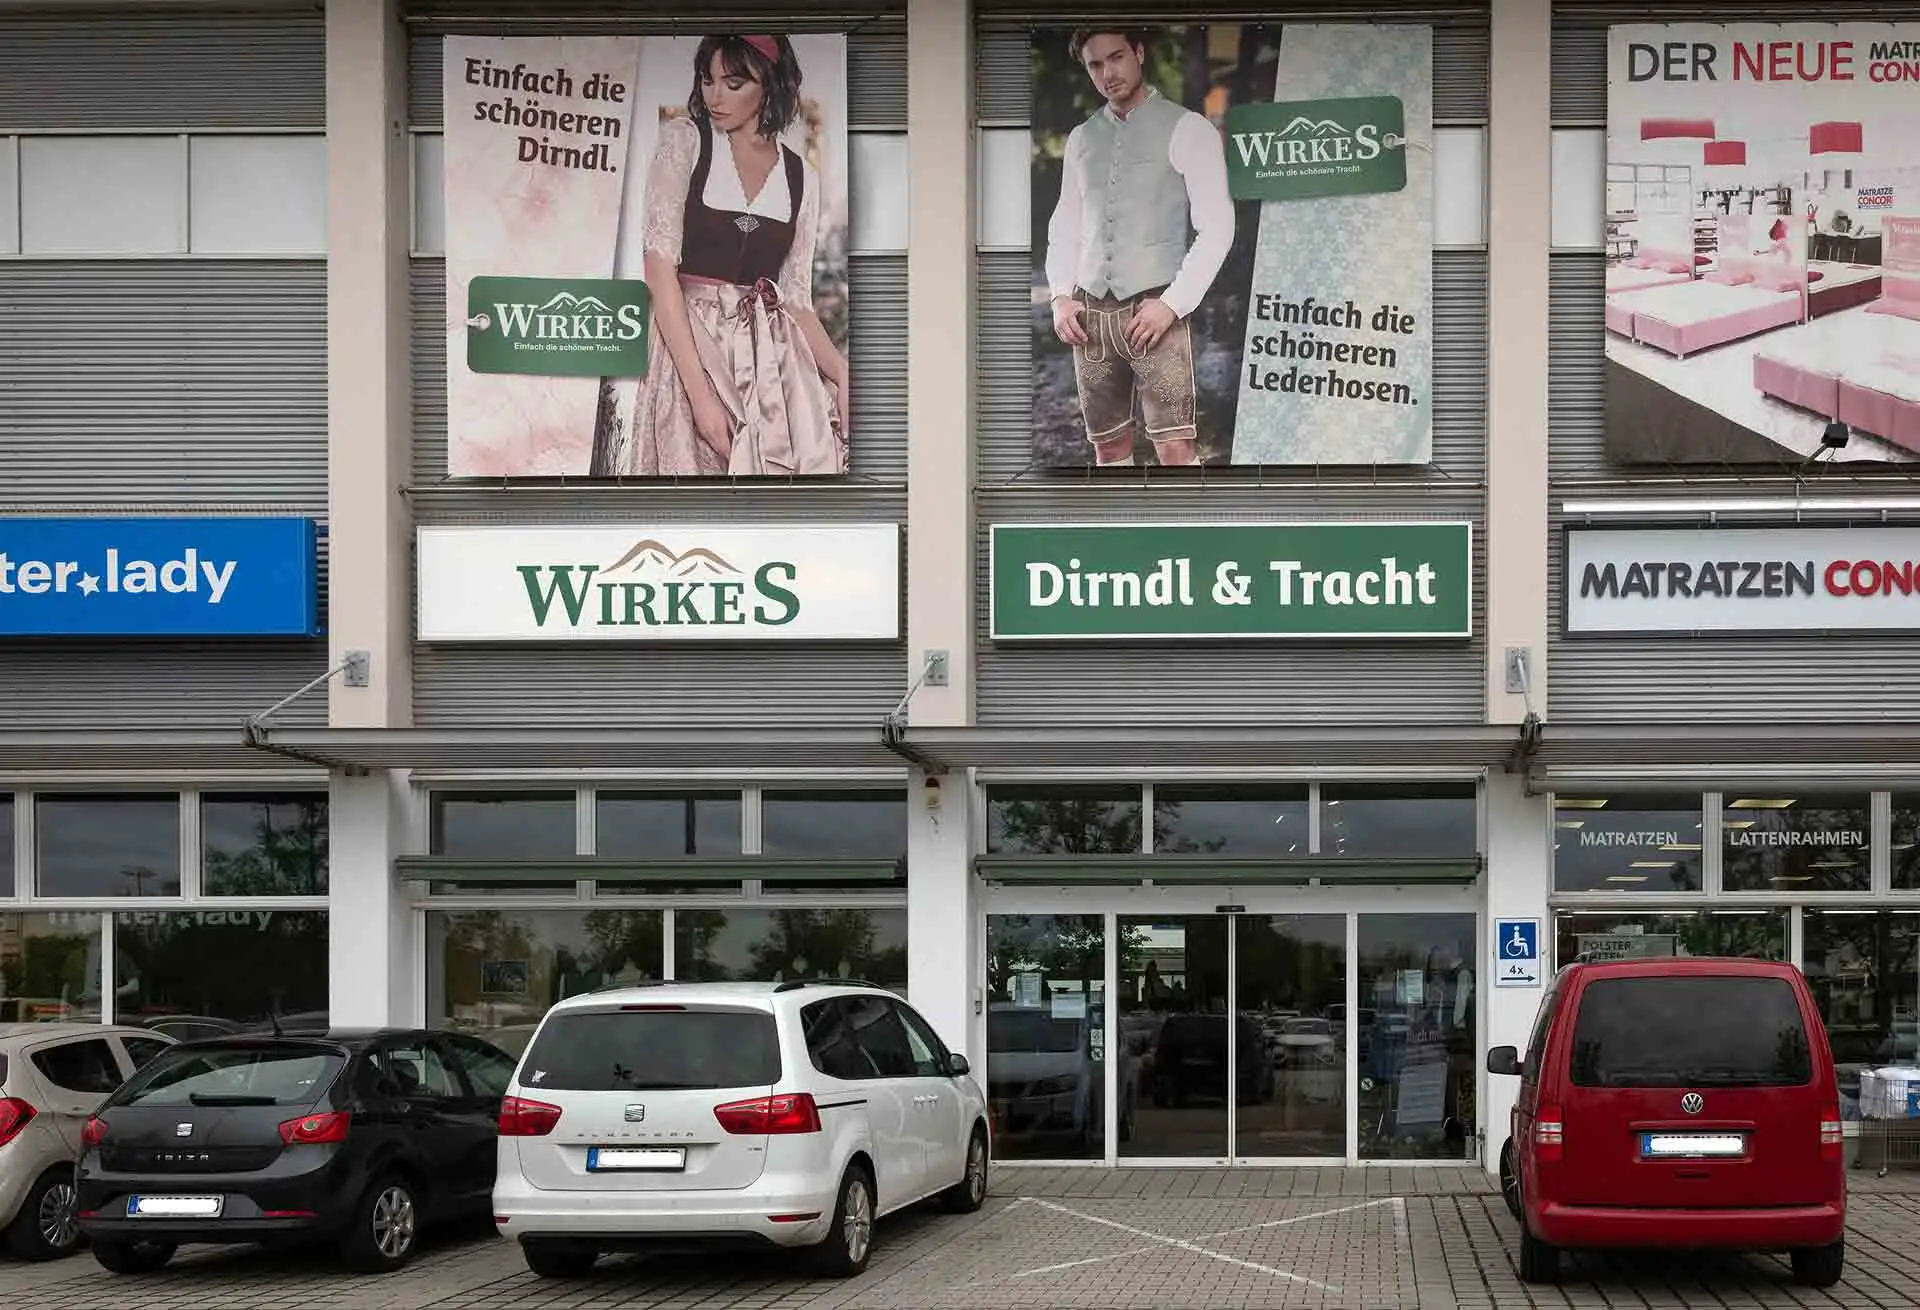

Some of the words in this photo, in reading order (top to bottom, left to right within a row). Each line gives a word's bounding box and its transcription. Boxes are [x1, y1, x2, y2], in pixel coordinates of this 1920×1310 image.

[465, 57, 573, 97] Einfach
[582, 73, 626, 103] die
[1628, 42, 1717, 82] DER
[1733, 41, 1854, 82] NEUE
[474, 97, 621, 138] schöneren
[518, 136, 617, 173] Dirndl.
[1255, 294, 1362, 329] Einfach
[1371, 304, 1416, 334] die
[513, 342, 544, 351] Einfach
[1250, 330, 1397, 369] schöneren
[1248, 364, 1418, 406] Lederhosen.
[516, 561, 801, 627] WIRKES
[1025, 558, 1194, 607] Dirndl
[1211, 560, 1252, 605] &
[1269, 557, 1437, 606] Tracht
[1580, 561, 1815, 598] MATRATZEN
[1824, 560, 1920, 597] CON
[1580, 831, 1678, 847] MATRATZEN
[1730, 831, 1863, 846] LATTENRAHMEN
[1509, 964, 1524, 975] 4x
